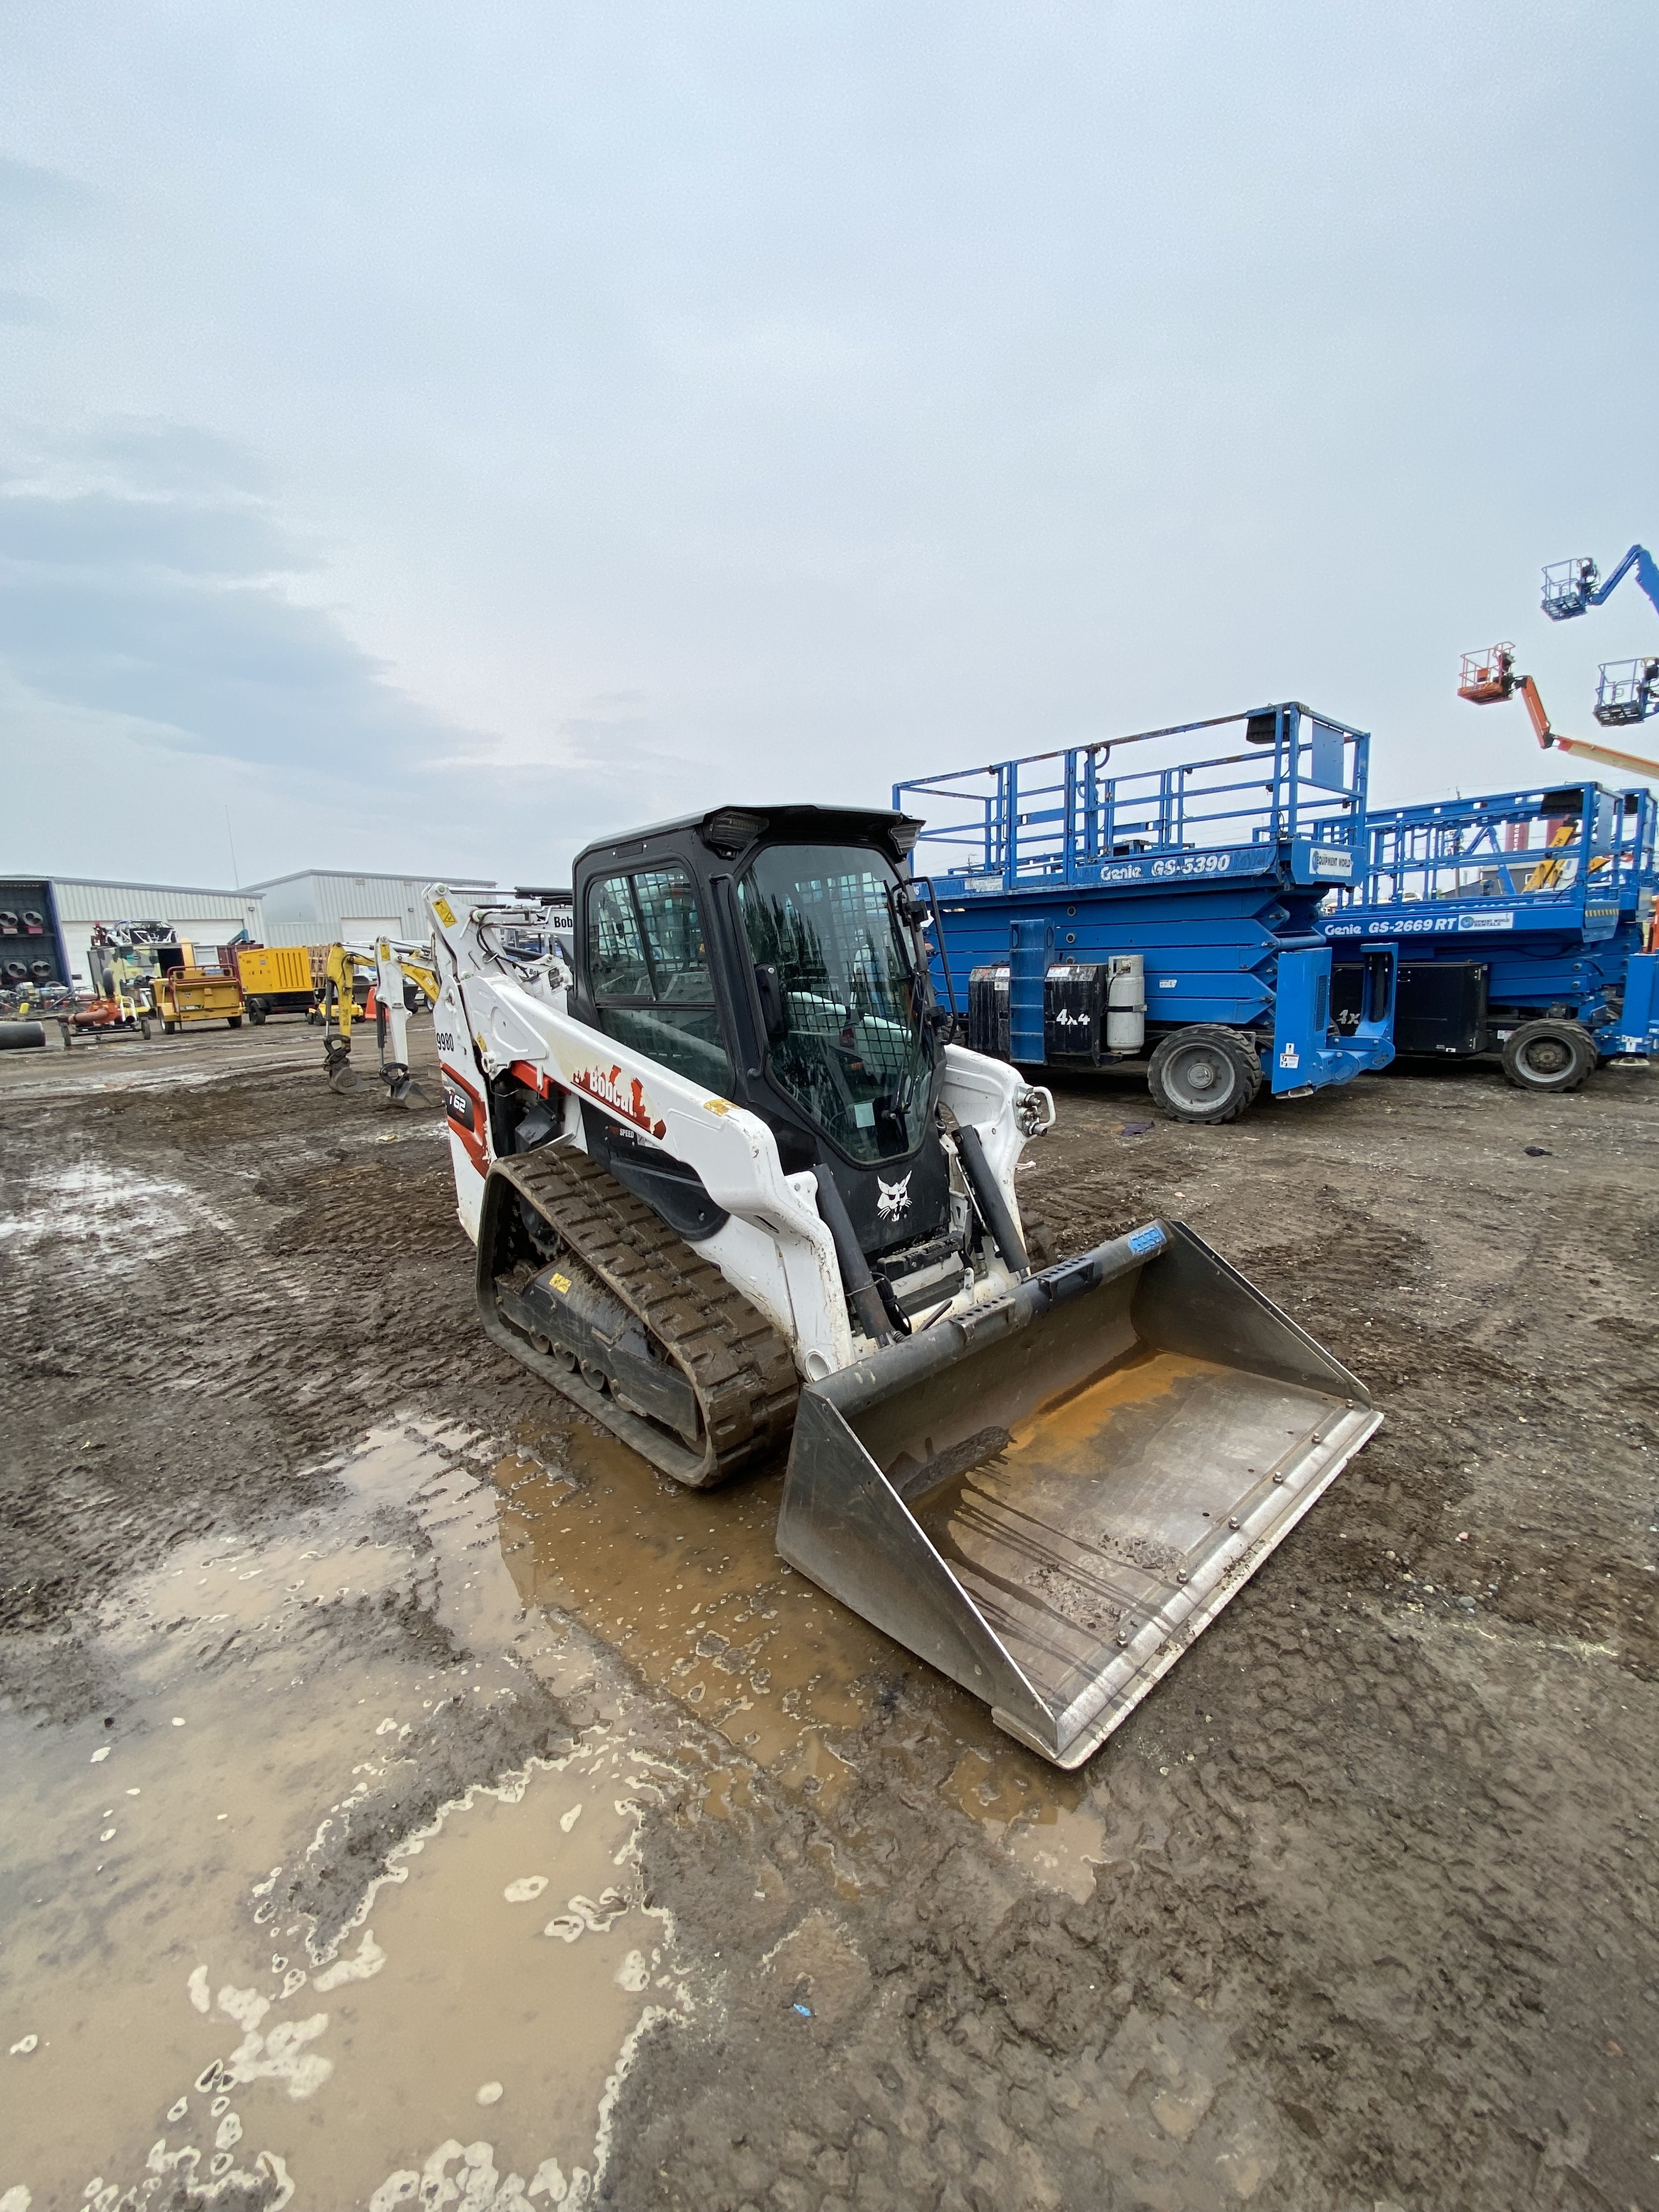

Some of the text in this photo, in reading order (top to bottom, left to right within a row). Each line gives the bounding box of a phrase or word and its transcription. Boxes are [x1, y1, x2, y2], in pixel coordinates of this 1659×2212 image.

[1101, 854, 1230, 881] Genie GS-5390
[554, 916, 573, 928] Bob
[1324, 924, 1361, 936] Genie
[1368, 918, 1434, 934] GS-2669
[1434, 918, 1457, 931] RT
[436, 1032, 454, 1052] 9980
[620, 1128, 634, 1138] SPEED
